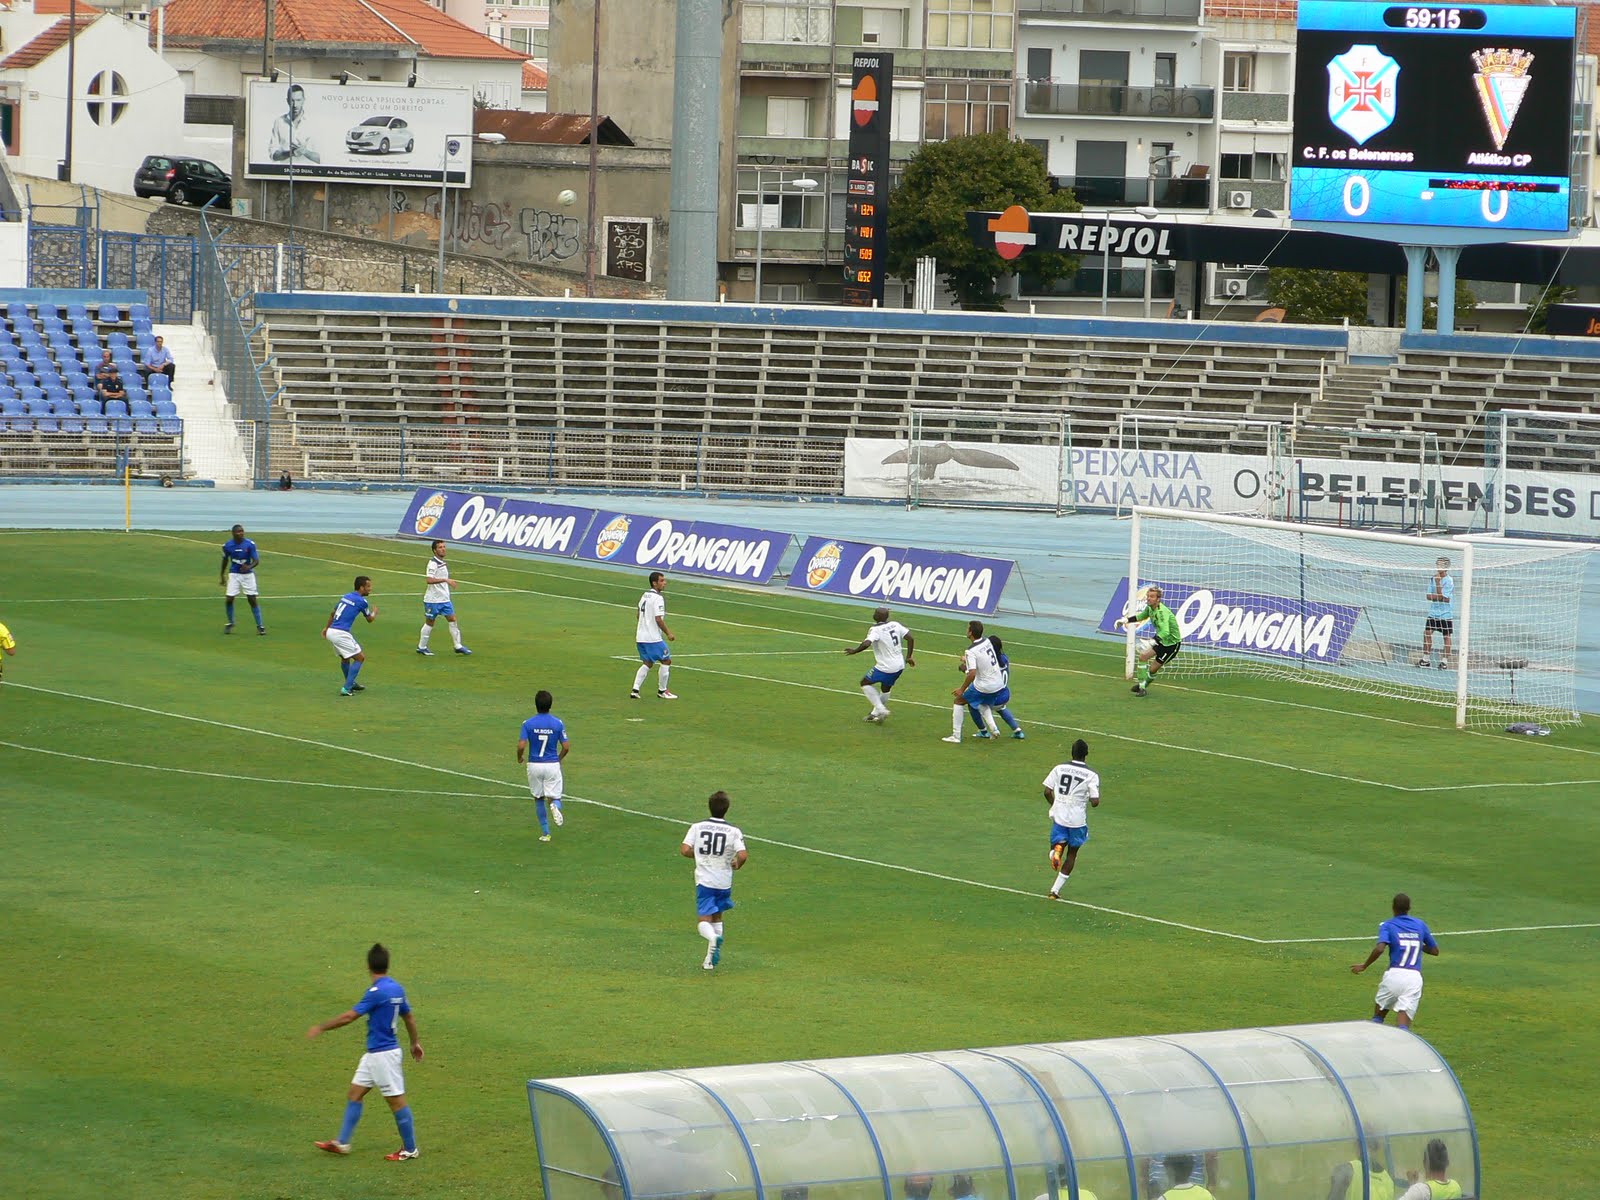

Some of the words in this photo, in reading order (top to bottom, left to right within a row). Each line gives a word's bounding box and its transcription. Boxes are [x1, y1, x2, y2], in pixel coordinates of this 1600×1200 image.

[1406, 8, 1461, 29] 59:15
[853, 57, 880, 68] REPSOL
[376, 96, 406, 104] YPSILON
[851, 158, 874, 174] BASIC
[1303, 147, 1316, 158] C.
[1319, 147, 1329, 159] F.
[1332, 149, 1347, 160] os
[1349, 148, 1414, 162] Belenenses
[1513, 153, 1532, 167] CP
[1343, 175, 1370, 217] 0
[1058, 224, 1170, 255] REPSOL
[1066, 449, 1203, 480] PEIXARIA
[1059, 479, 1214, 510] PRAIA-MAR
[451, 495, 576, 552] ORANGINA
[636, 520, 771, 578] ORANGINA
[849, 546, 993, 609] ORANGINA
[1175, 590, 1335, 657] ORANGINA
[889, 630, 899, 647] 5
[986, 647, 997, 666] 3
[538, 734, 549, 757] 7
[1059, 773, 1086, 796] 97
[699, 830, 727, 856] 30
[1399, 940, 1421, 967] 77
